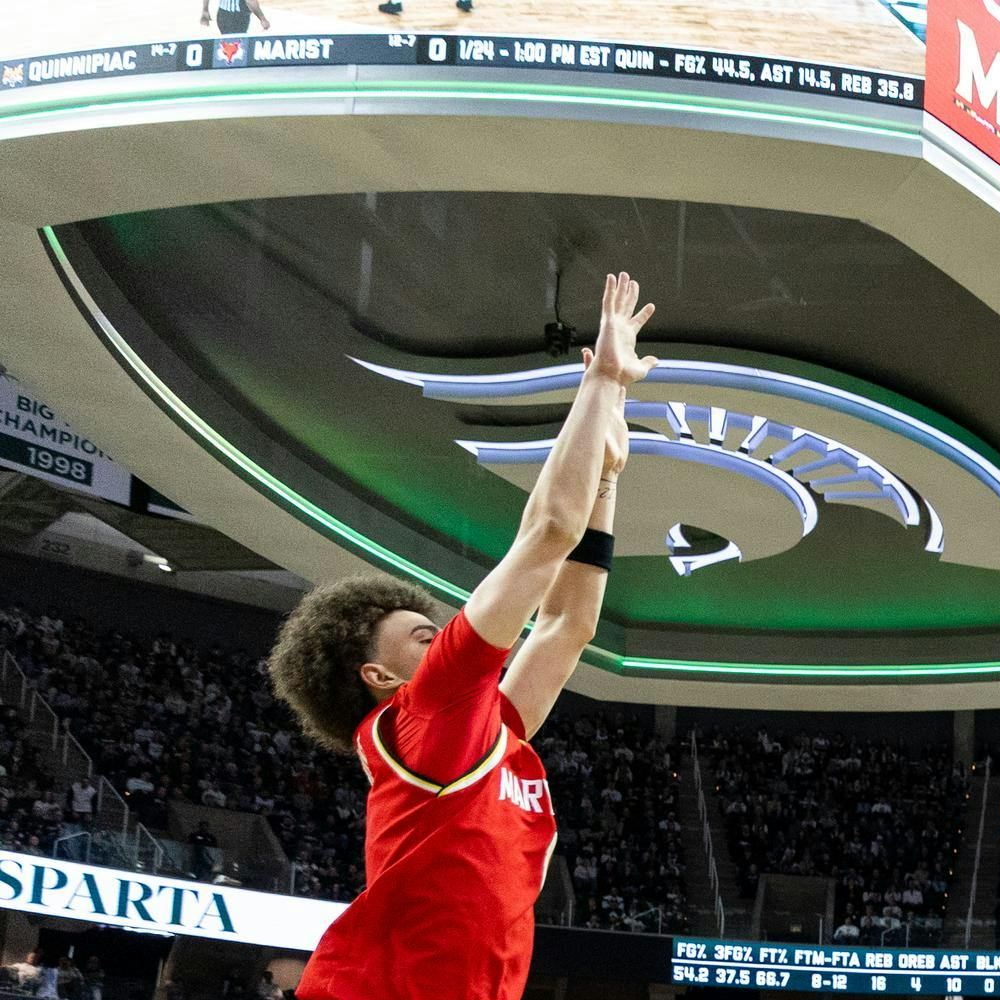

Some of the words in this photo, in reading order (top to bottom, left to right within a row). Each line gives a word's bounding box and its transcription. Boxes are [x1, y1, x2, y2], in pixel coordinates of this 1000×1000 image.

[28, 50, 137, 82] QUINNIPIAC
[186, 43, 203, 67] 0
[253, 38, 334, 61] MARIST
[428, 38, 447, 61] 0
[459, 39, 495, 61] 1/24
[514, 41, 546, 63] 1:00
[551, 43, 575, 65] PM
[579, 45, 611, 67] EST
[614, 48, 654, 70] QUIN
[674, 53, 706, 75] FG%
[712, 57, 756, 82] 44.5,
[760, 63, 793, 84] AST
[798, 67, 836, 92] 14.5,
[841, 73, 872, 95] REB
[877, 78, 914, 101] 35.8
[17, 395, 55, 421] BIG
[0, 410, 113, 461] HAMPIO
[27, 447, 87, 481] 1998
[0, 859, 238, 933] SPARTA
[677, 942, 707, 959] FG%
[714, 944, 753, 963] 3FG%
[759, 947, 788, 964] FT%
[794, 949, 860, 968] FTM-FTA
[865, 952, 893, 969] REB
[898, 953, 935, 970] OREB
[940, 954, 969, 971] AST
[673, 966, 709, 983] 54.2
[715, 968, 750, 985] 37.5
[910, 976, 922, 992] 4
[946, 977, 962, 993] 10
[984, 977, 995, 993] 0
